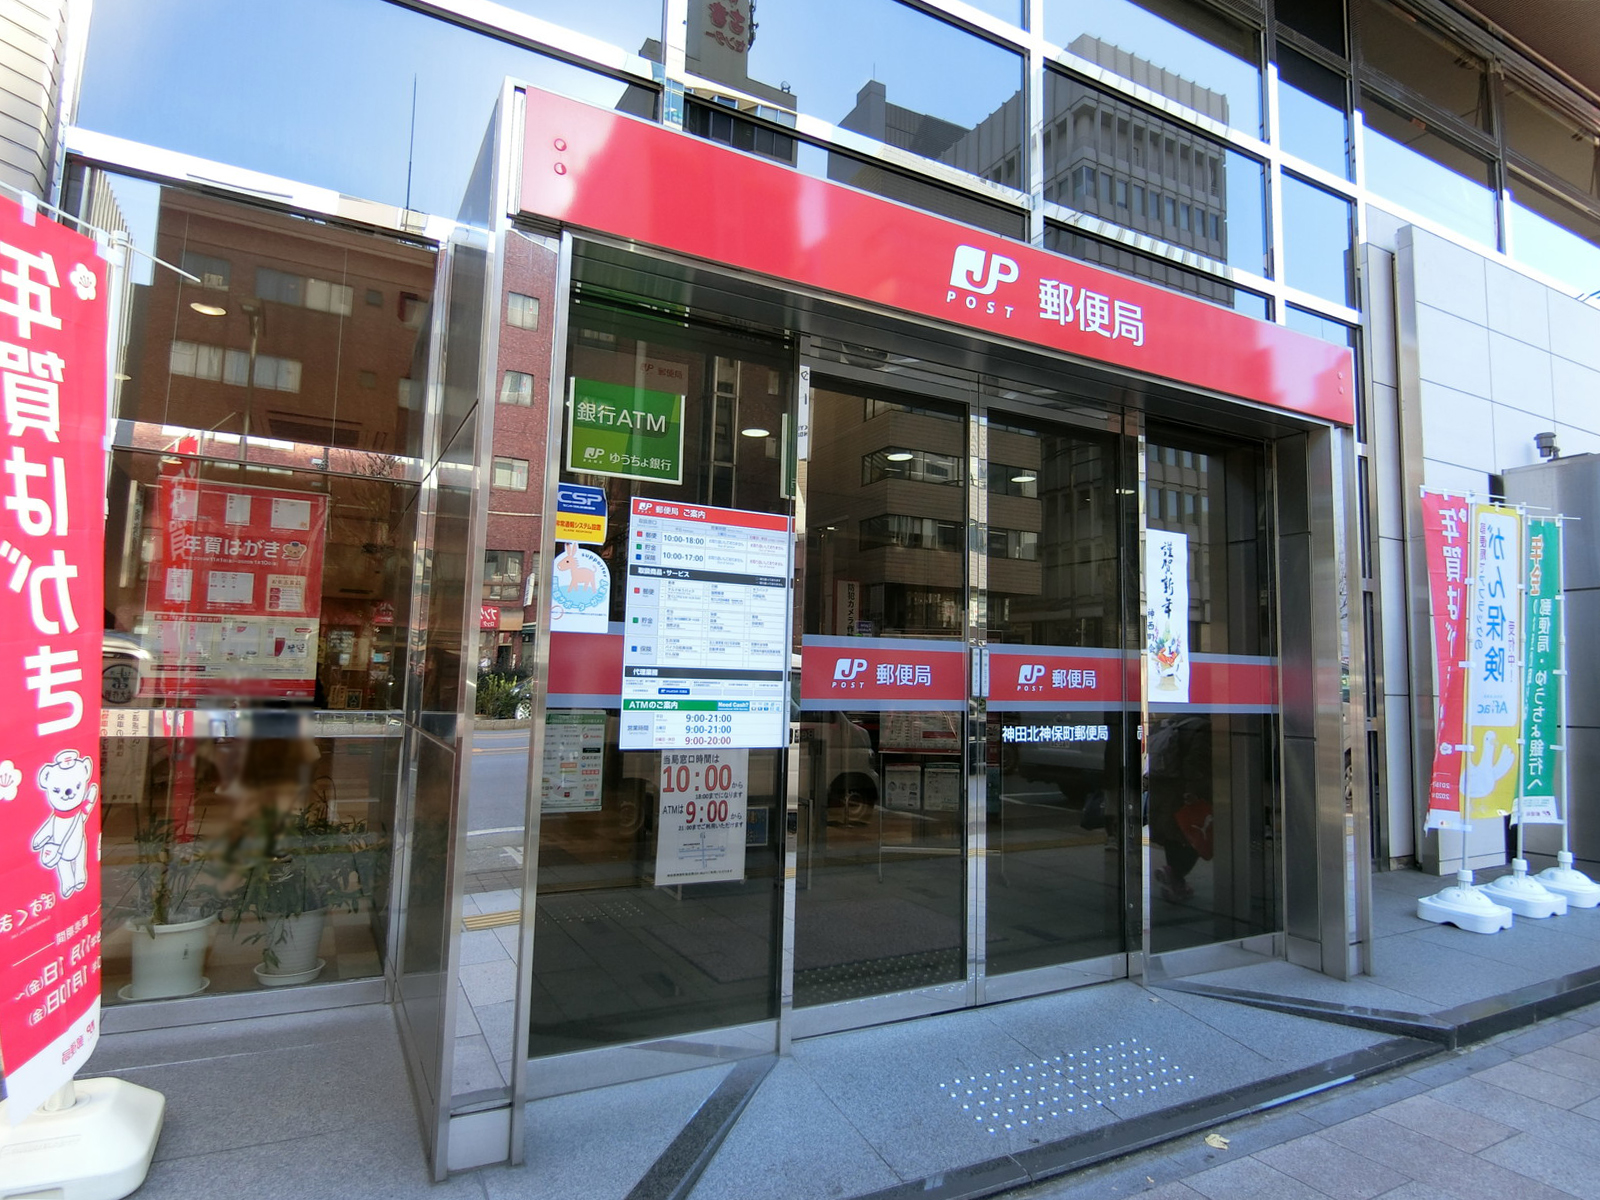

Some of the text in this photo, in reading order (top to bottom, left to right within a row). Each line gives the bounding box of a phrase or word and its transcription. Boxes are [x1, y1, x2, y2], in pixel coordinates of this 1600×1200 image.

[946, 290, 1014, 319] POST
[1039, 278, 1144, 347] 郵便局
[576, 401, 666, 433] 銀行ATM
[609, 452, 672, 471] ゆうちょ銀行
[557, 490, 603, 507] CSP
[655, 505, 706, 519] 郵便局 ご案内
[182, 535, 281, 558] 年賀はがき
[663, 534, 704, 546] 10:00-18:00
[581, 552, 608, 579] supporter
[663, 551, 704, 562] 10:00-17:00
[876, 664, 932, 686] 郵便局
[1051, 669, 1097, 689] 郵便局
[831, 681, 866, 689] POST
[629, 701, 679, 710] ATMのご案内
[685, 714, 732, 723] 9:00-21:00
[685, 725, 732, 734] 9:00-21:00
[1001, 725, 1110, 743] 神田北神保町郵便局
[685, 736, 732, 746] 9:00-20:00
[662, 764, 744, 793] 10:00 から
[662, 804, 684, 815] ATMは
[685, 800, 729, 824] 9:00
